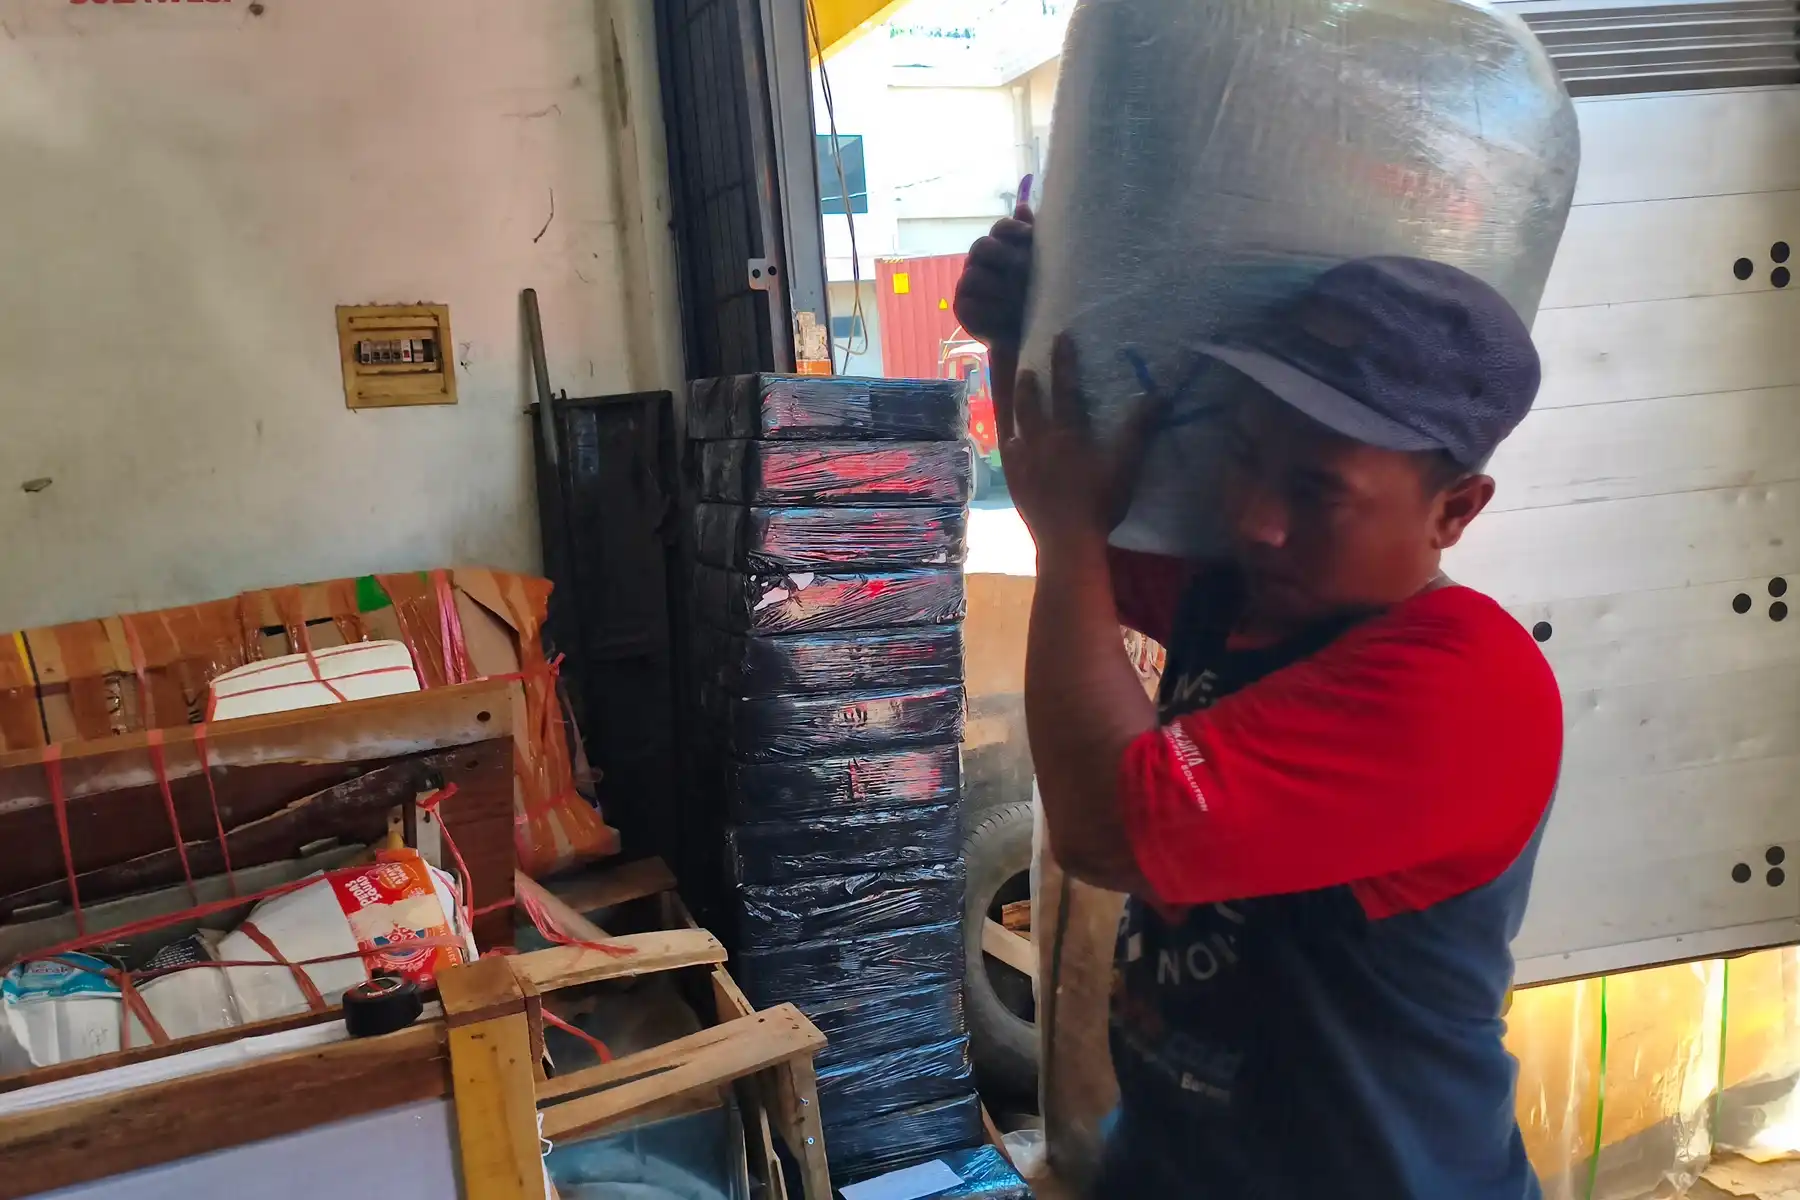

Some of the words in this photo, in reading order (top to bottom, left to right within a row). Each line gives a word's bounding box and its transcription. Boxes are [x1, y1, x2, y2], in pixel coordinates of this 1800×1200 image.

[1180, 764, 1209, 812] SOLUTION
[344, 879, 374, 907] PEDAS
[356, 875, 384, 902] SQUAD
